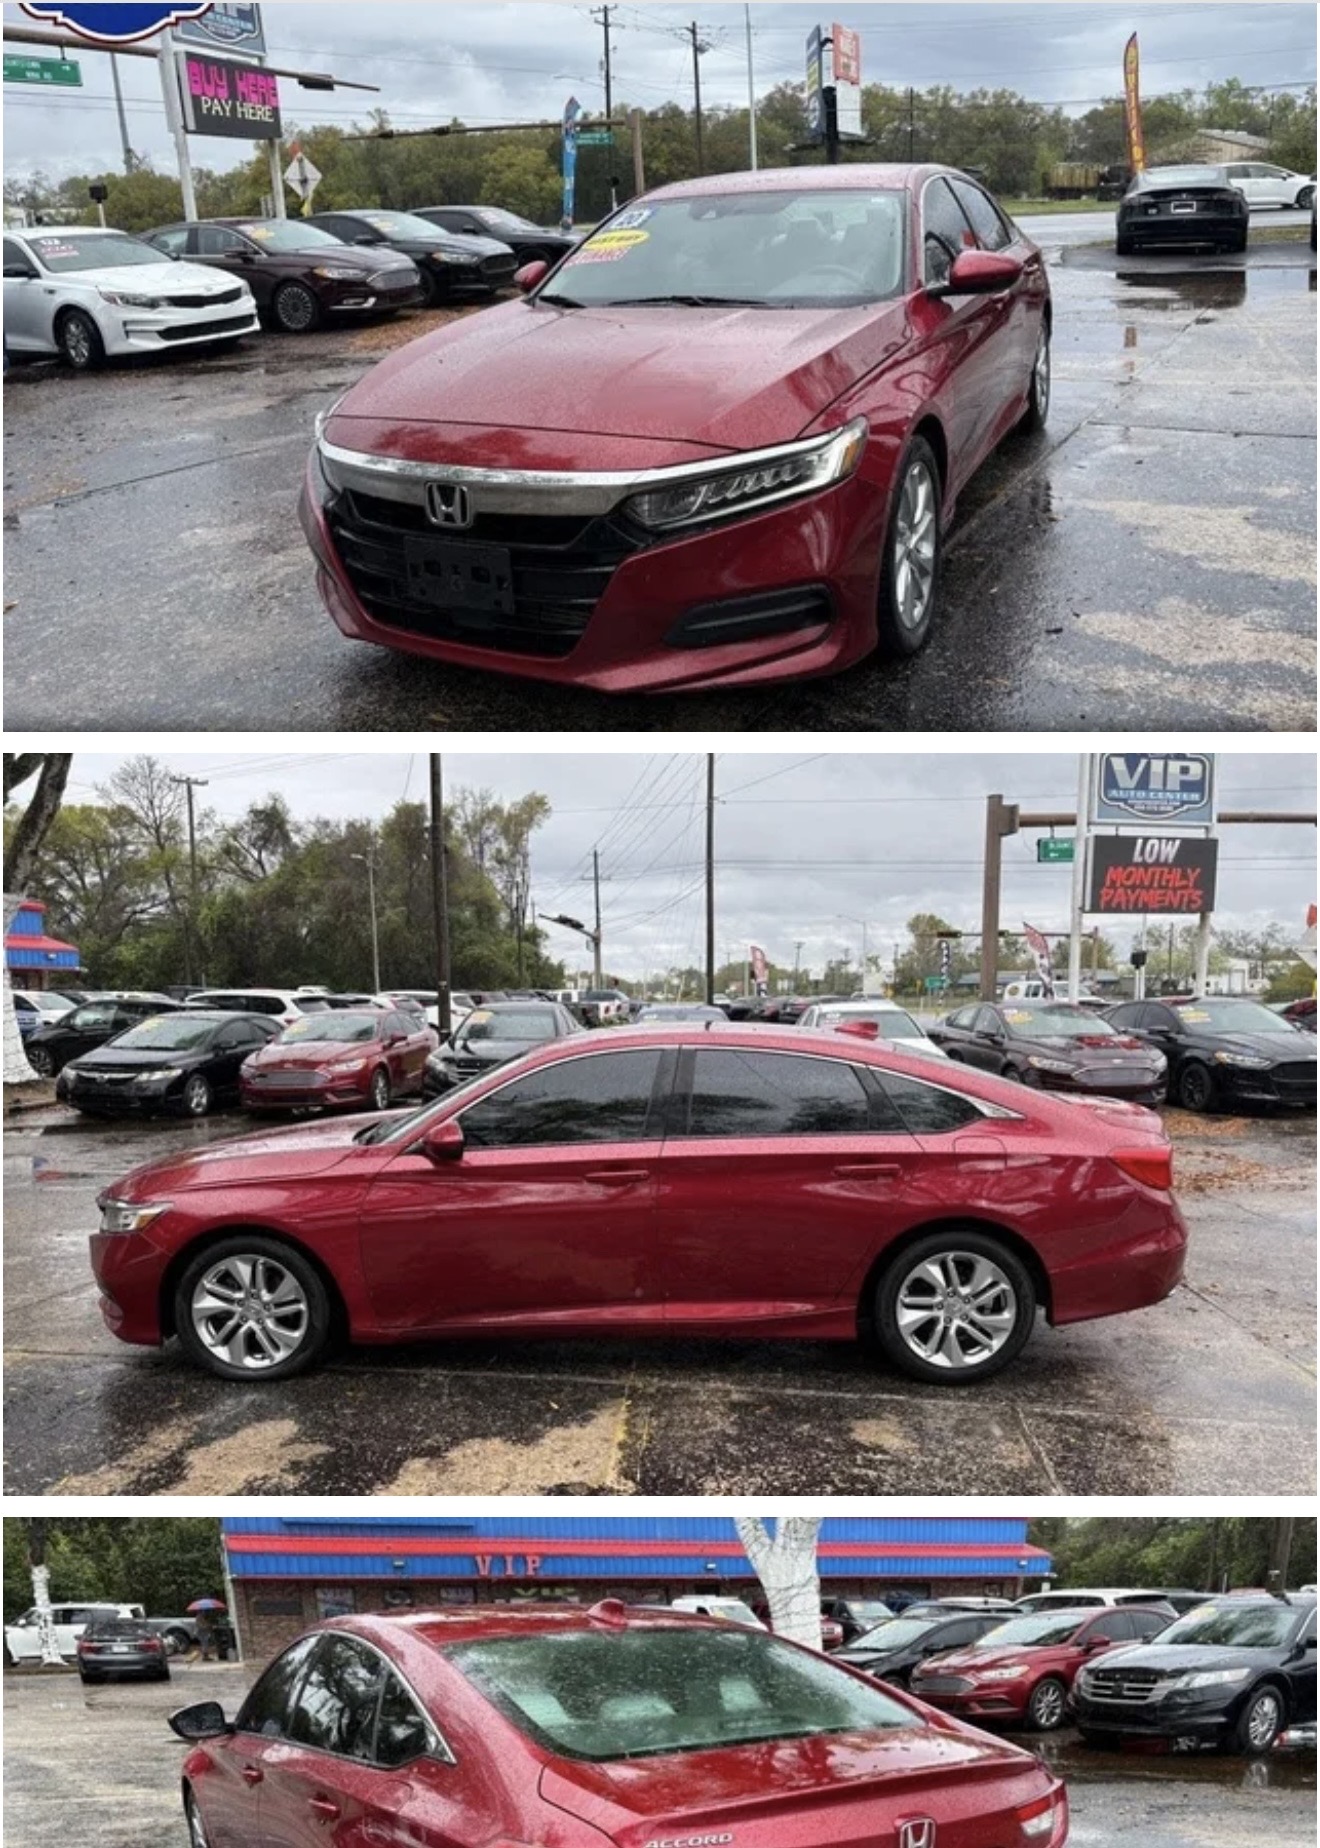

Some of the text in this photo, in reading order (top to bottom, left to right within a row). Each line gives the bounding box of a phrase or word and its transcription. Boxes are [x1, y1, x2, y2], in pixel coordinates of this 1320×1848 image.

[187, 60, 278, 108] BUY HERE
[201, 96, 275, 122] PAY HERE
[1109, 756, 1203, 790] VIP
[1107, 790, 1201, 801] AUTO CENTER
[1132, 838, 1181, 863] LOW
[1105, 865, 1201, 888] MONTHLY
[1100, 887, 1204, 911] PAYMENTS
[475, 1555, 541, 1576] VIP
[645, 1832, 734, 1848] ACCORD
